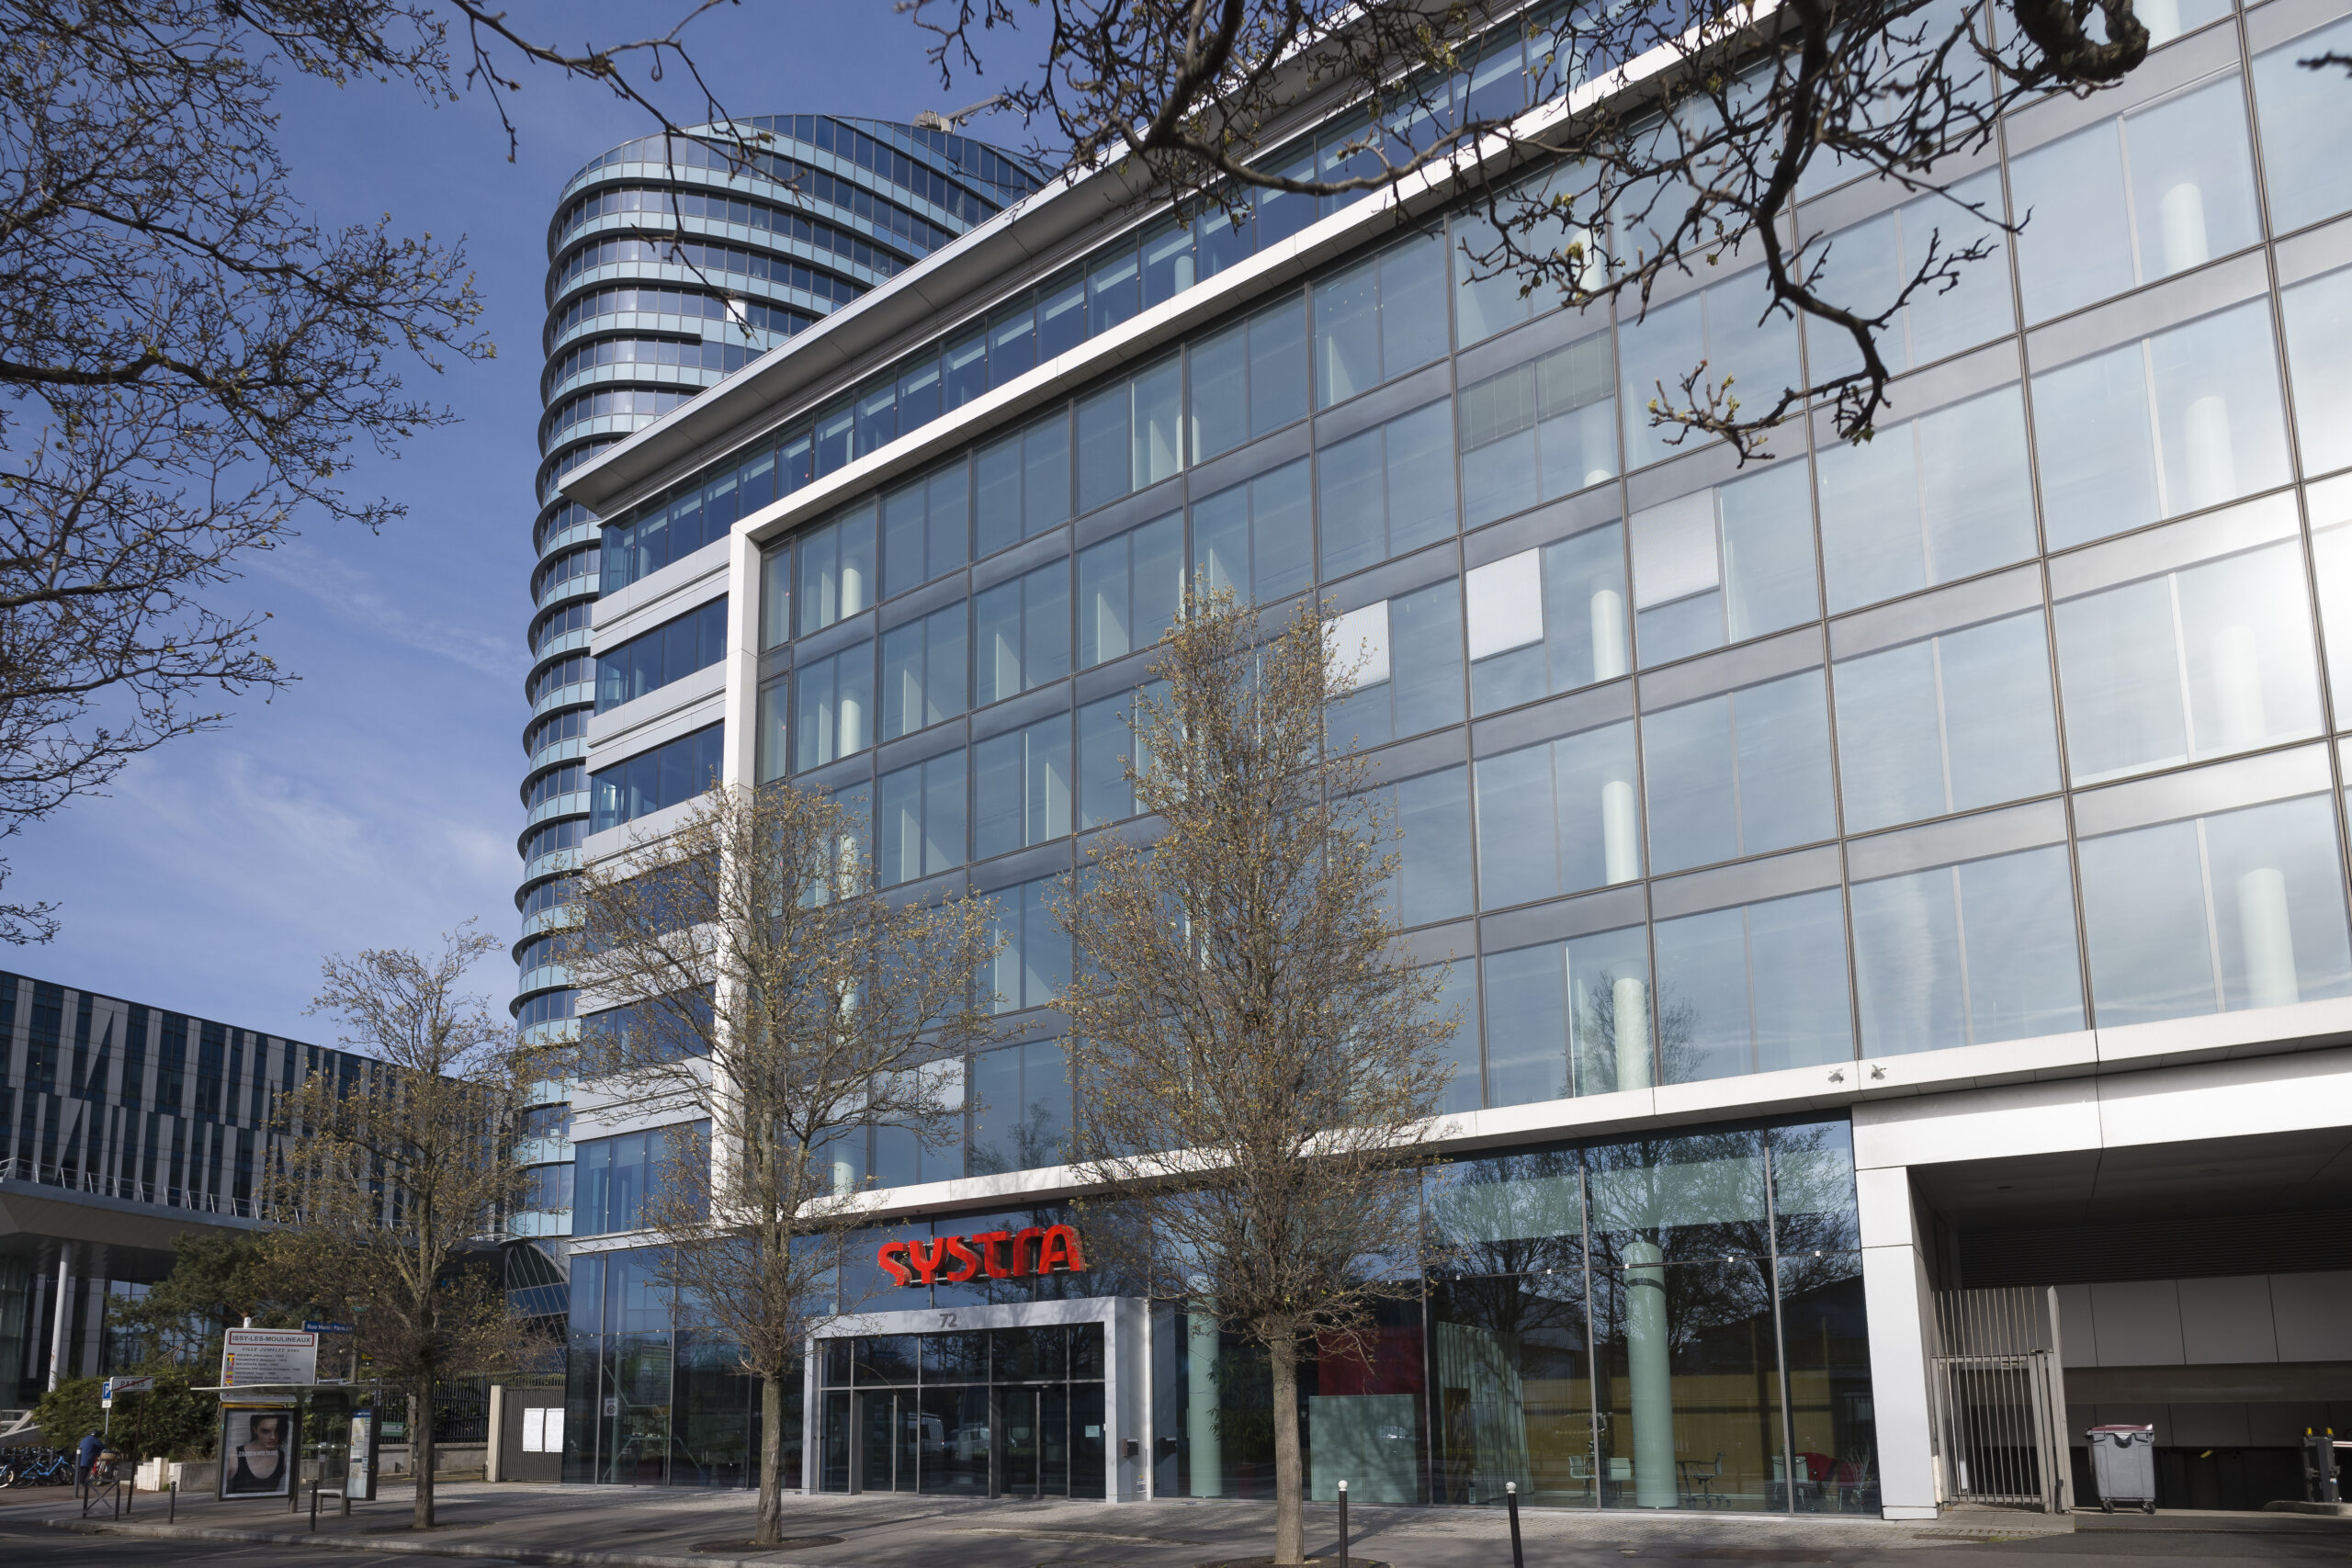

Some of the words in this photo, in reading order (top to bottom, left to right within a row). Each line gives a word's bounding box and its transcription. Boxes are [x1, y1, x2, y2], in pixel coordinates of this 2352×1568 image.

[877, 1224, 1086, 1286] SYSTRA
[939, 1313, 957, 1327] 72
[232, 1335, 311, 1343] ISSY-LES-MOULINEAUX
[105, 1385, 110, 1396] P
